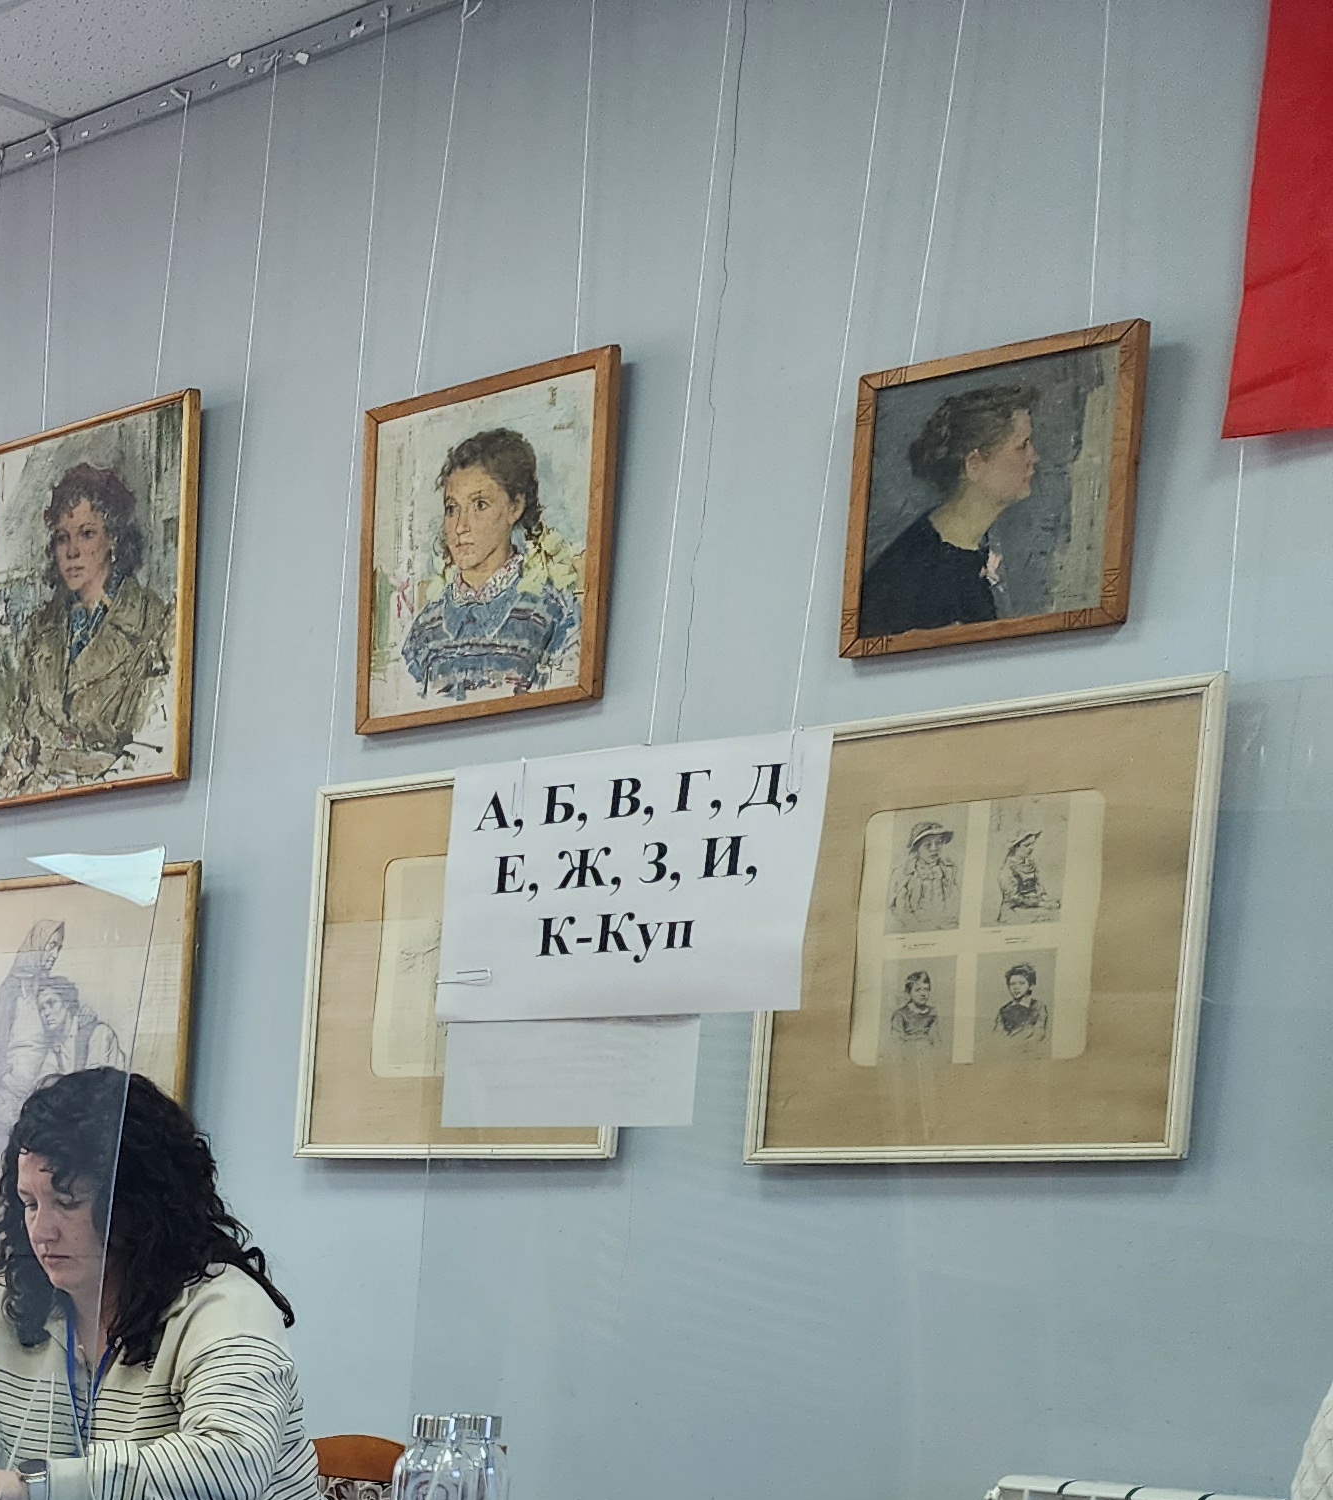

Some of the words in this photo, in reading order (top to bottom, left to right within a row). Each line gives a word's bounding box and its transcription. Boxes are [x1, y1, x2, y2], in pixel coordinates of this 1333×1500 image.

[473, 791, 524, 837] А,
[540, 783, 587, 831] Б,
[604, 777, 653, 826] В,
[671, 769, 722, 820] Г,
[737, 762, 798, 818] Д,
[492, 854, 539, 902] Е,
[554, 846, 621, 896] Ж,
[638, 841, 681, 891] З,
[697, 835, 757, 886] И,
[535, 912, 695, 963] К-Куп
